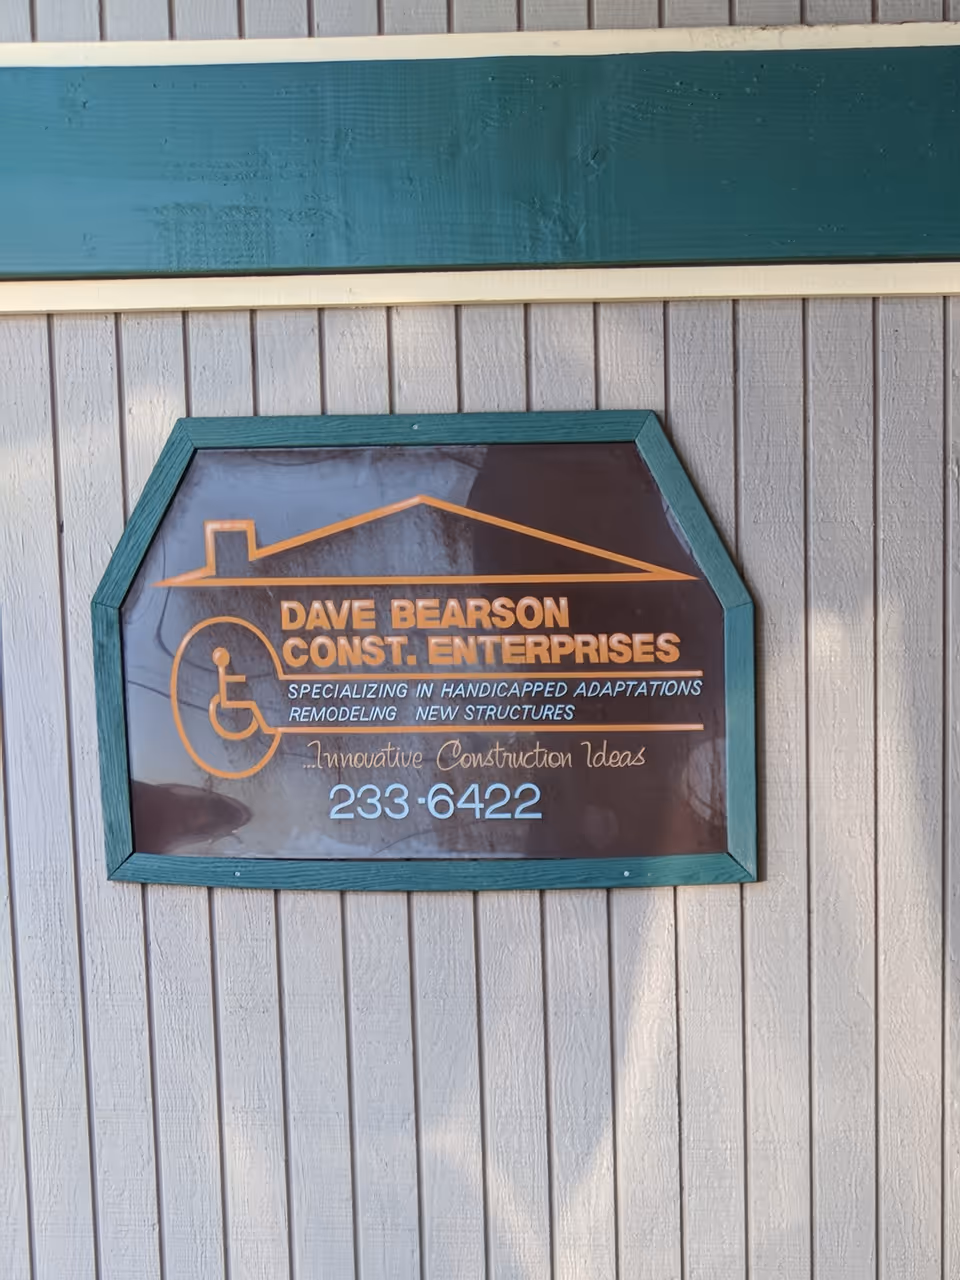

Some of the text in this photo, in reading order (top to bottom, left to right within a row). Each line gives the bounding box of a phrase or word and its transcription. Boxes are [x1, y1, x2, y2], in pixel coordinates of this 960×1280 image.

[281, 596, 570, 631] DAVE BEARSON
[283, 632, 682, 668] CONST. ENTERPRISES
[288, 680, 703, 699] SPECIALIZING IN HANDICAPPED ADAPTATIONS
[289, 704, 576, 722] REMODELING NEW STRUCTURES
[436, 739, 572, 771] Construction
[581, 740, 646, 768] Ideas
